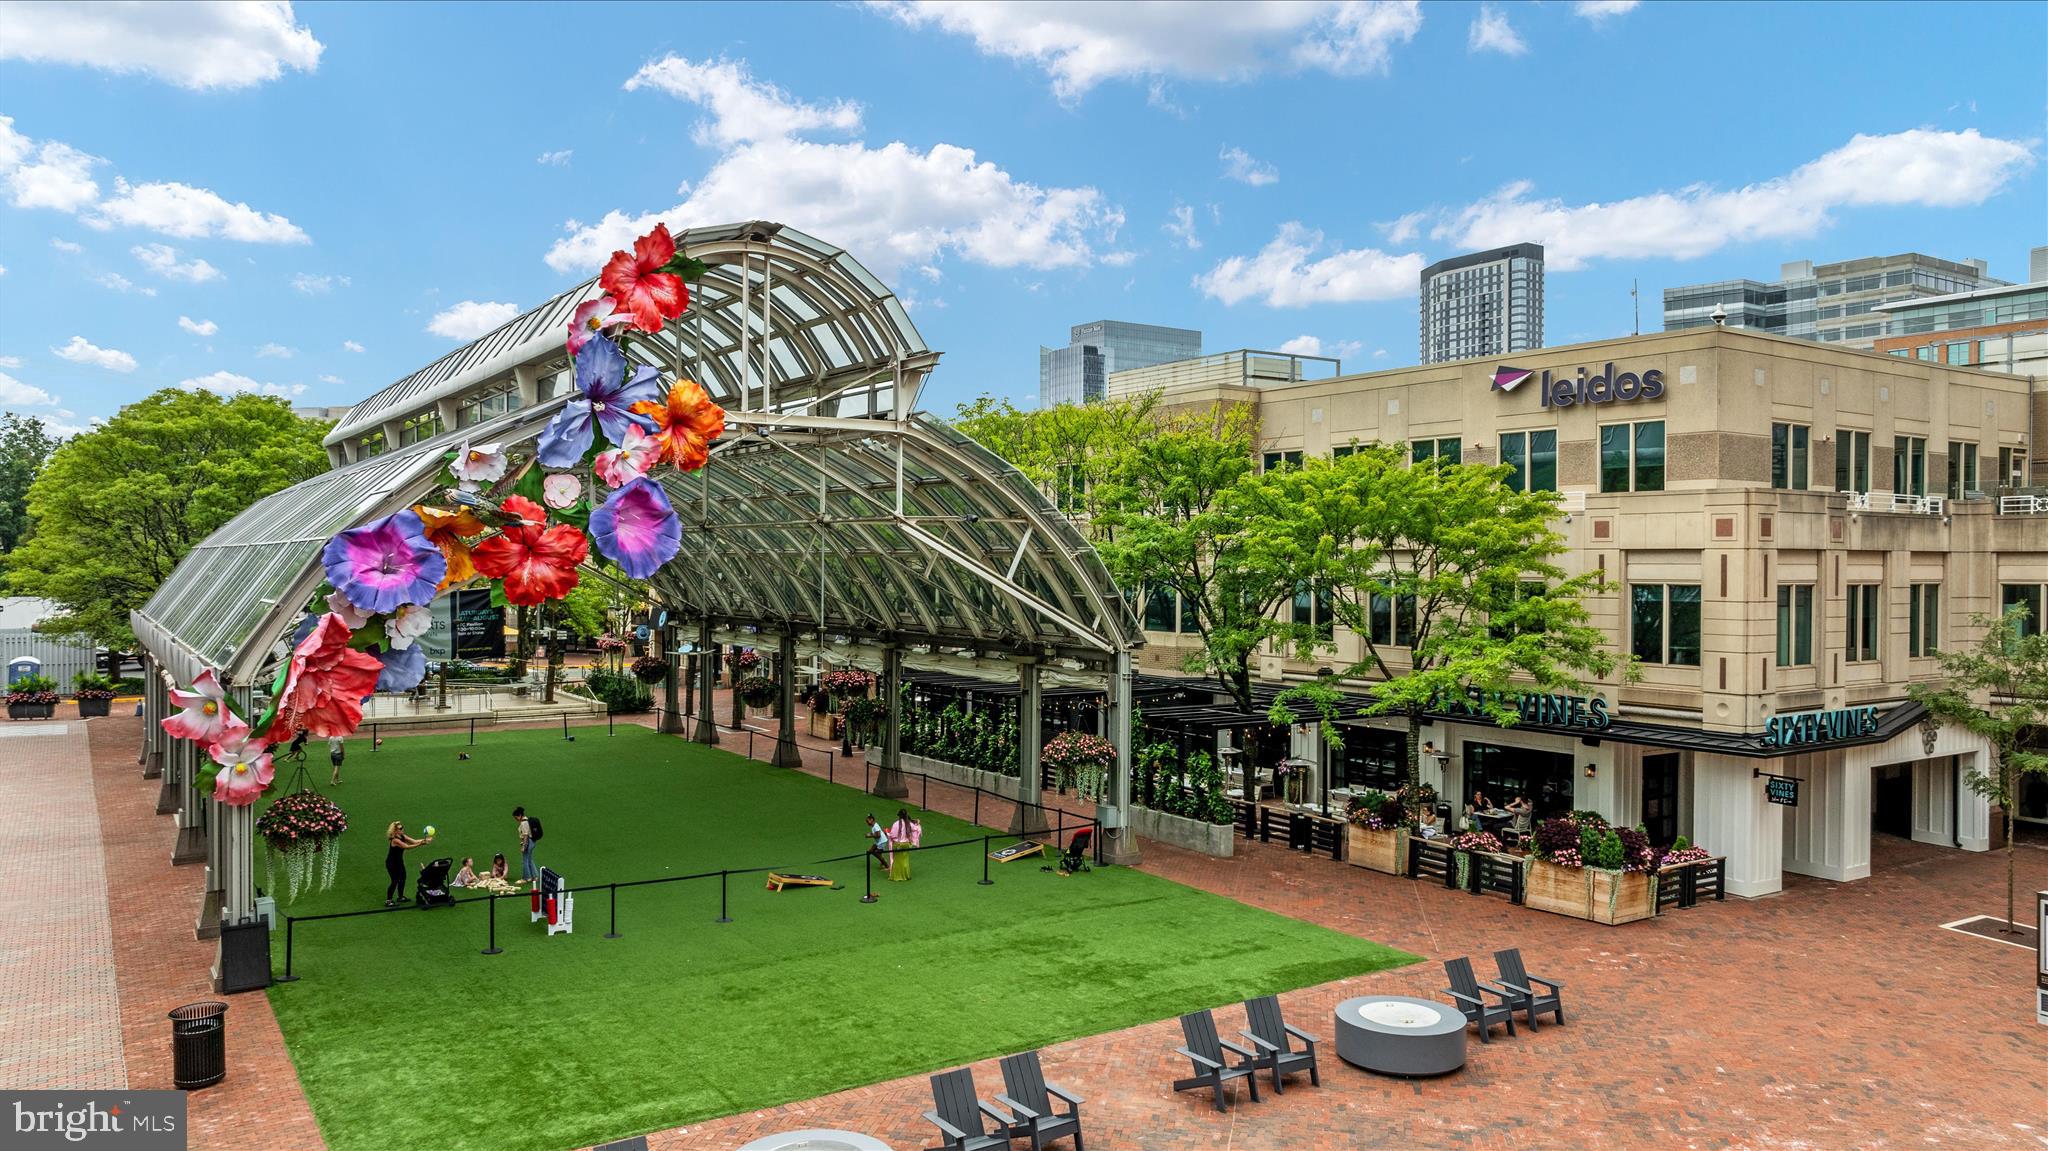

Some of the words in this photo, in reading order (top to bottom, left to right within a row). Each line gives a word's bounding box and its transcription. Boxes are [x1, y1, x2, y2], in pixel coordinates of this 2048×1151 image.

[1541, 362, 1664, 408] leidos
[1517, 692, 1609, 730] VINES
[1765, 711, 1824, 747] SIXTY
[1825, 706, 1879, 739] VINES
[1770, 780, 1794, 791] SIXTY
[1770, 788, 1794, 799] VINES
